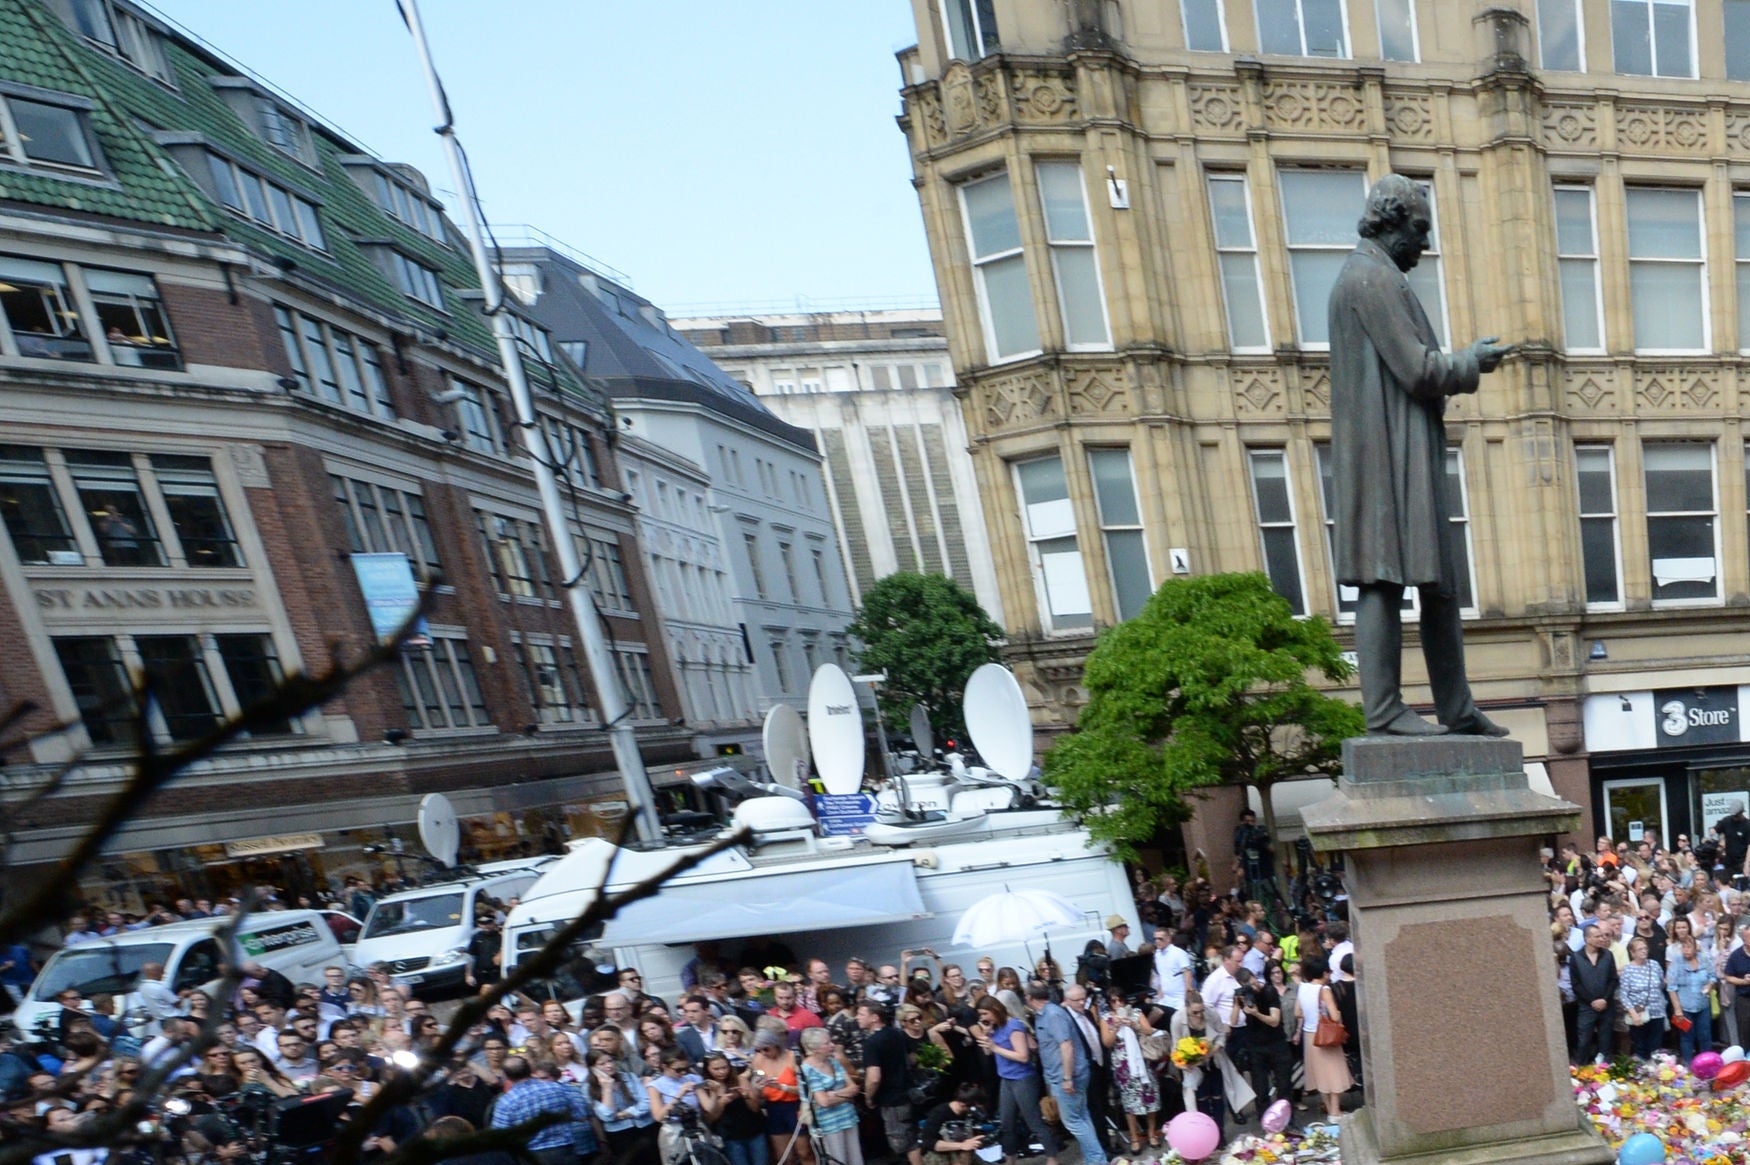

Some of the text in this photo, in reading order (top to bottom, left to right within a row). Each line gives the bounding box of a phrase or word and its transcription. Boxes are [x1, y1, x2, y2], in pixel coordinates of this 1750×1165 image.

[1661, 700, 1730, 736] 3 Store
[1705, 798, 1725, 807] Just
[245, 926, 318, 950] enterprise
